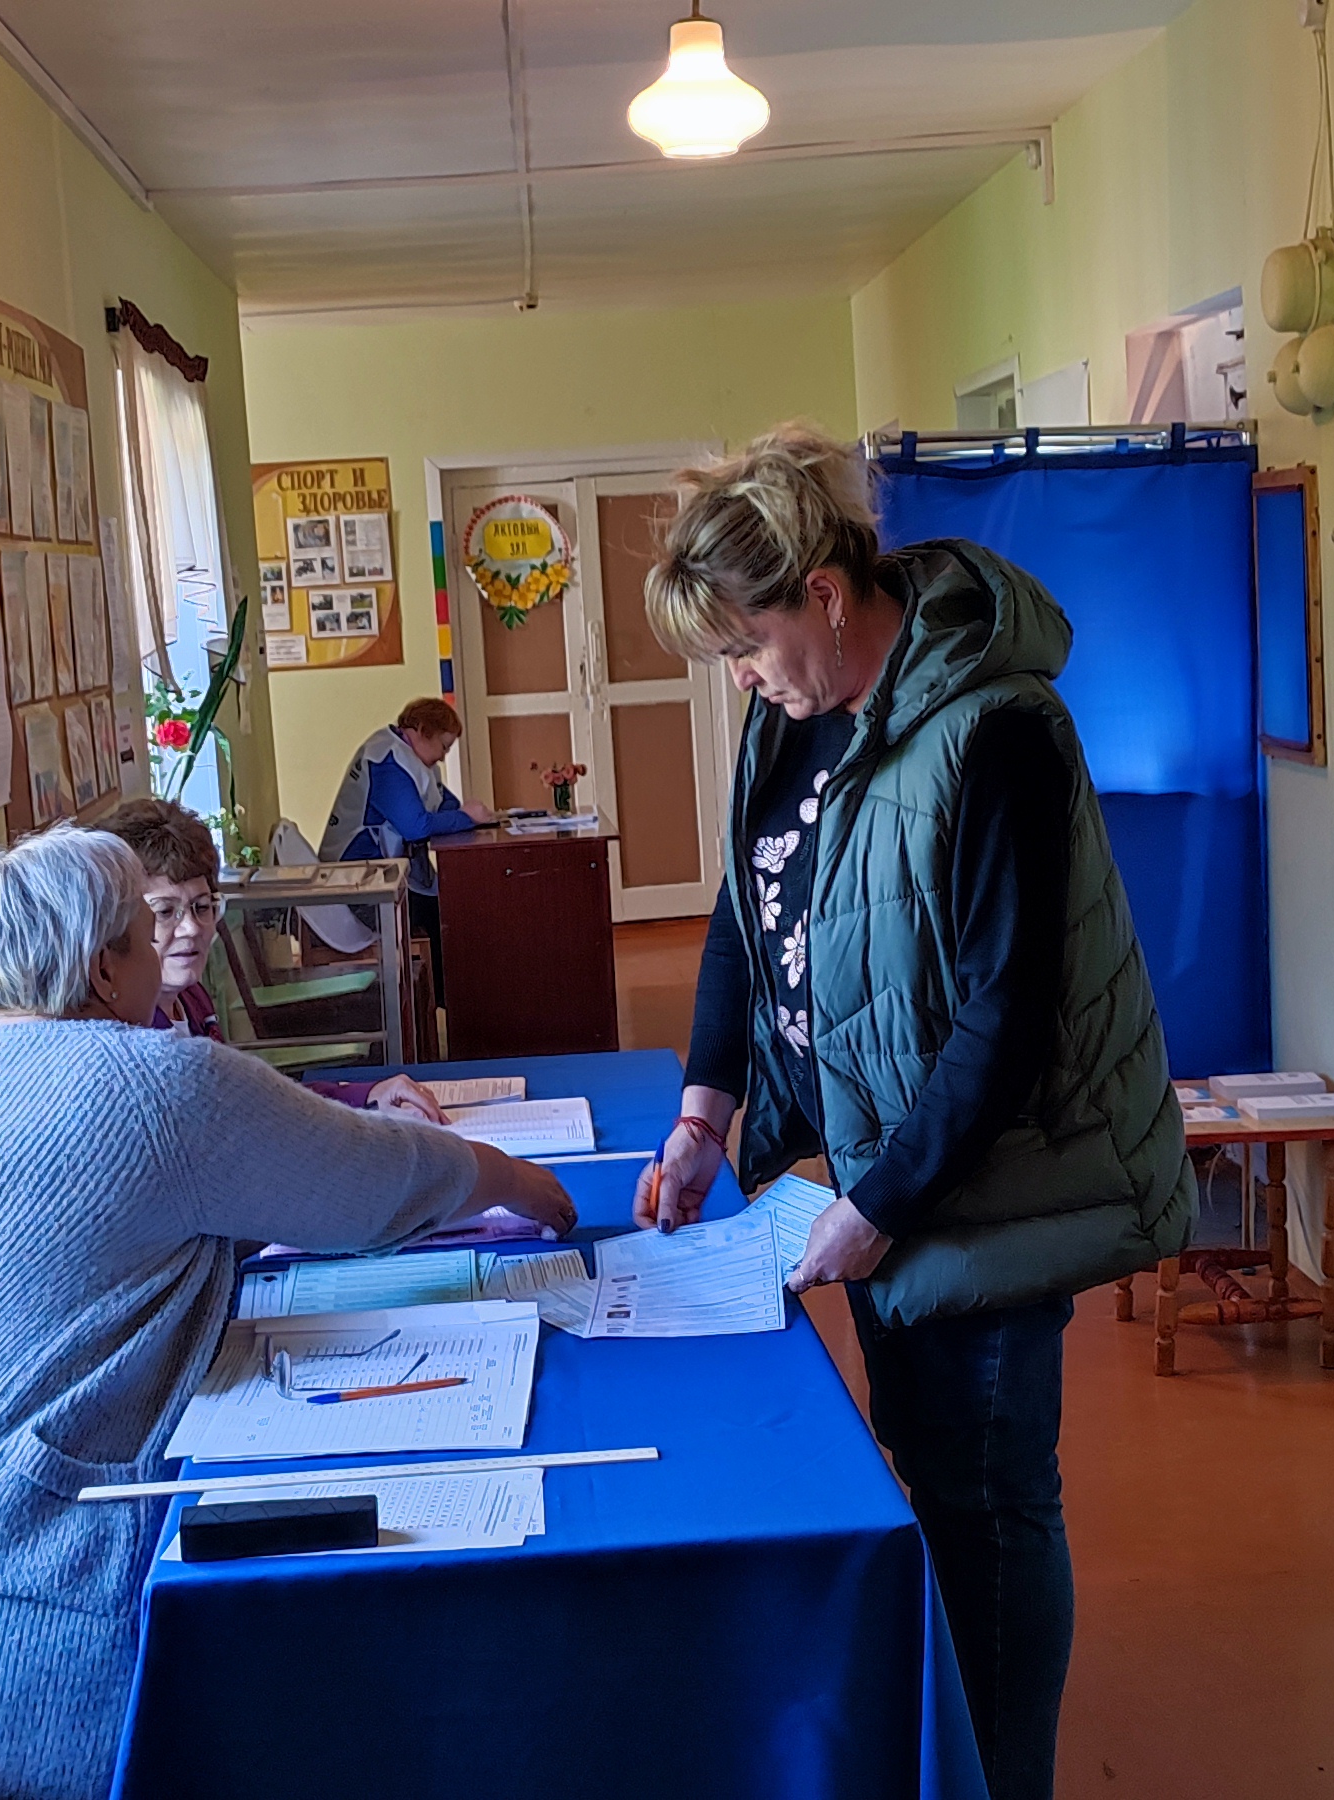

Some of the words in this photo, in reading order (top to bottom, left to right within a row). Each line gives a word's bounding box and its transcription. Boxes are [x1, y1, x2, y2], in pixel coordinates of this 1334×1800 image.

[277, 468, 338, 491] СПОРТ
[352, 467, 366, 488] И
[298, 488, 388, 515] ЗДОРОВЬЕ
[493, 522, 540, 537] АКТОВЫЙ
[510, 542, 528, 557] ЗАЛ
